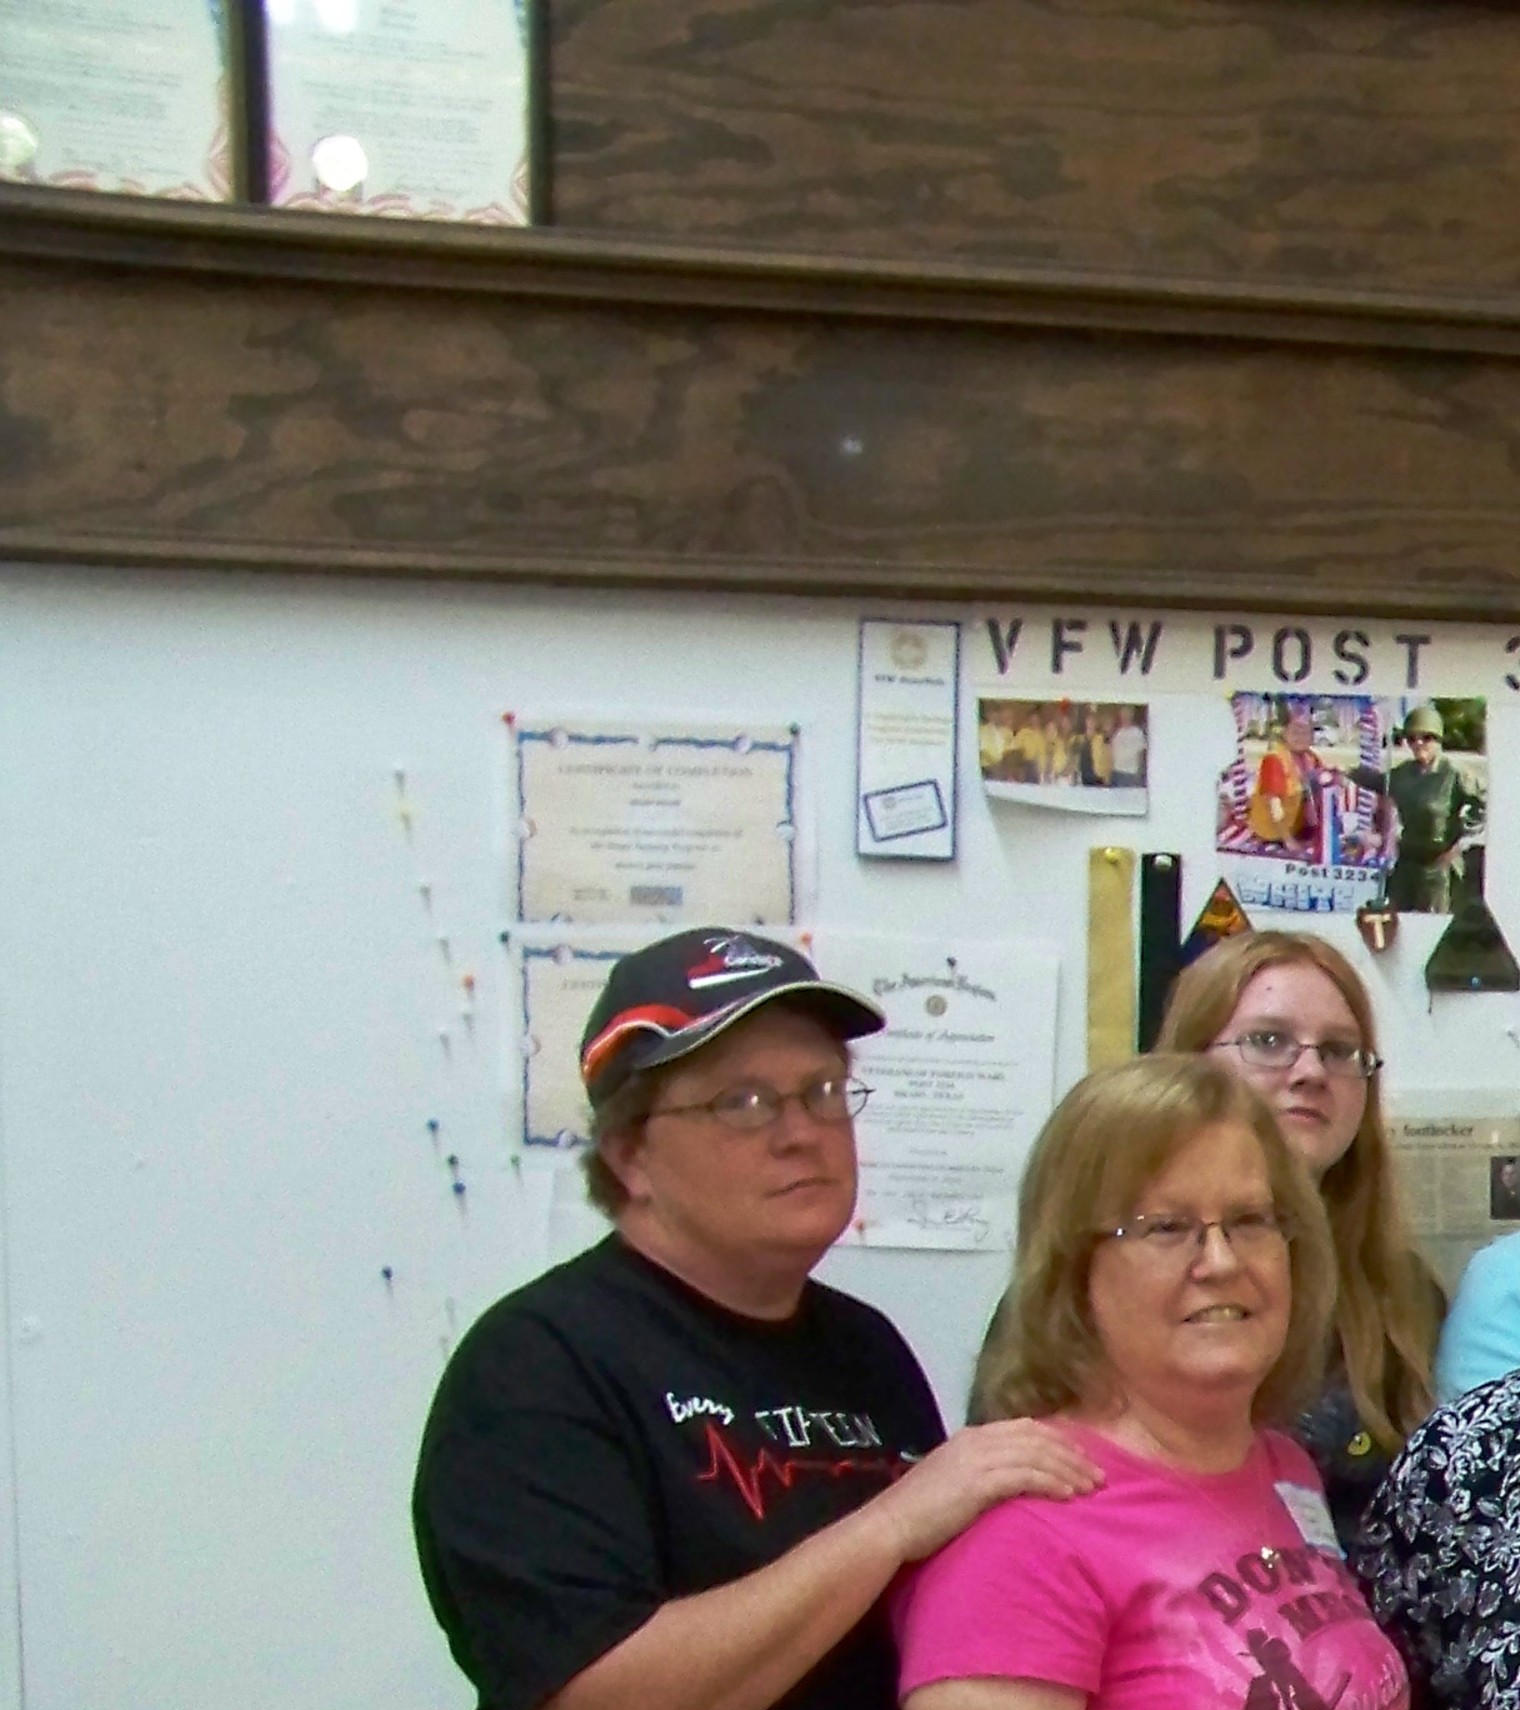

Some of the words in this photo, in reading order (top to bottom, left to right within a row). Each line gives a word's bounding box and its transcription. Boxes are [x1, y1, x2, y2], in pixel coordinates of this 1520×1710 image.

[986, 616, 1163, 675] VFW
[1212, 623, 1433, 688] POST
[1285, 864, 1328, 879] Post
